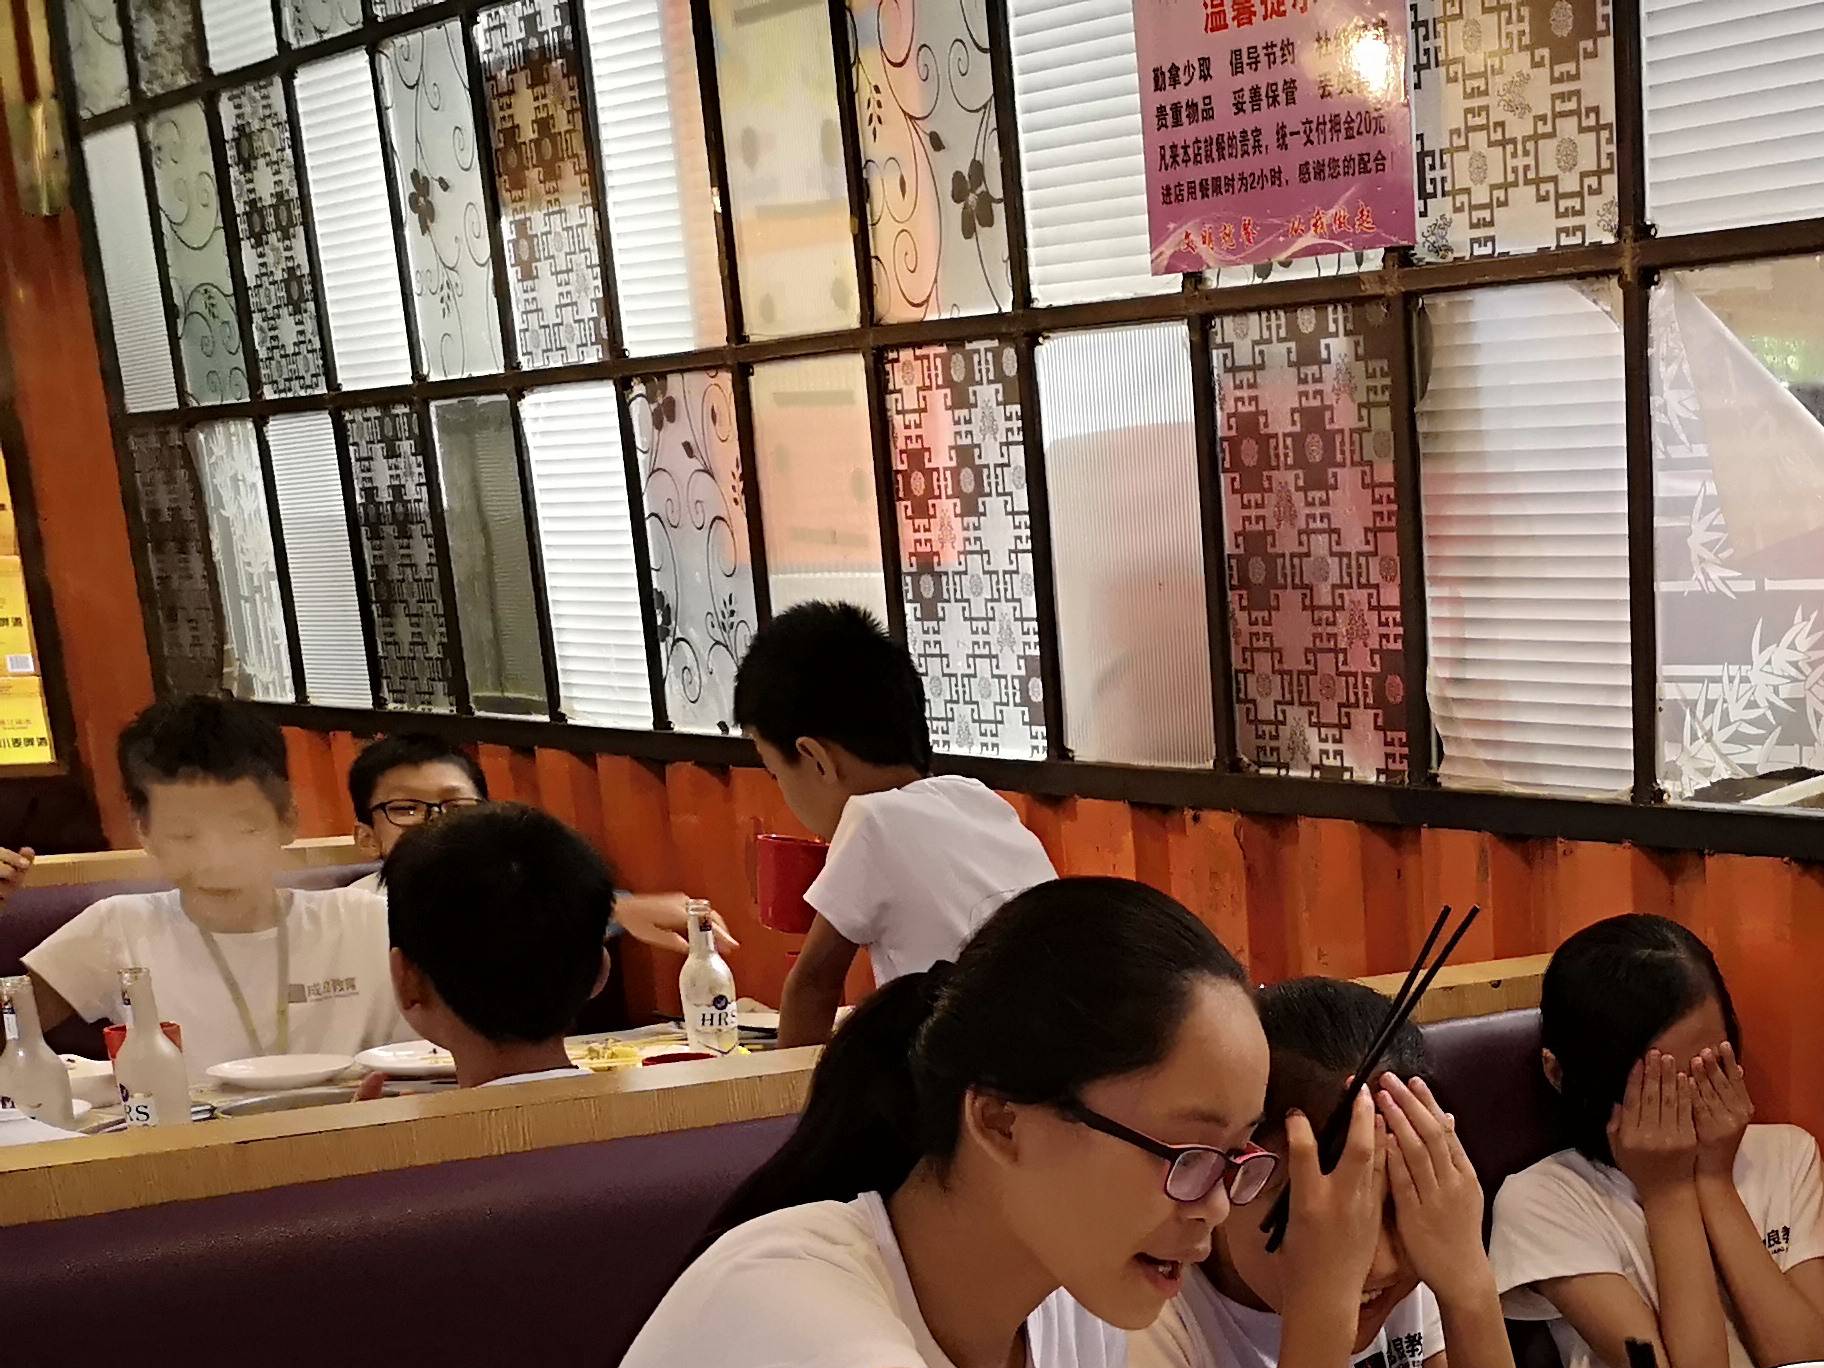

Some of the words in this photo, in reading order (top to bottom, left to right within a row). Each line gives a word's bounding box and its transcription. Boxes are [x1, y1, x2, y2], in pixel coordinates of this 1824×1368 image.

[1203, 0, 1318, 33] 温馨
[1229, 39, 1296, 77] 倡导节约
[1155, 95, 1215, 132] 贵重物品
[1231, 77, 1298, 117] 妥善保管
